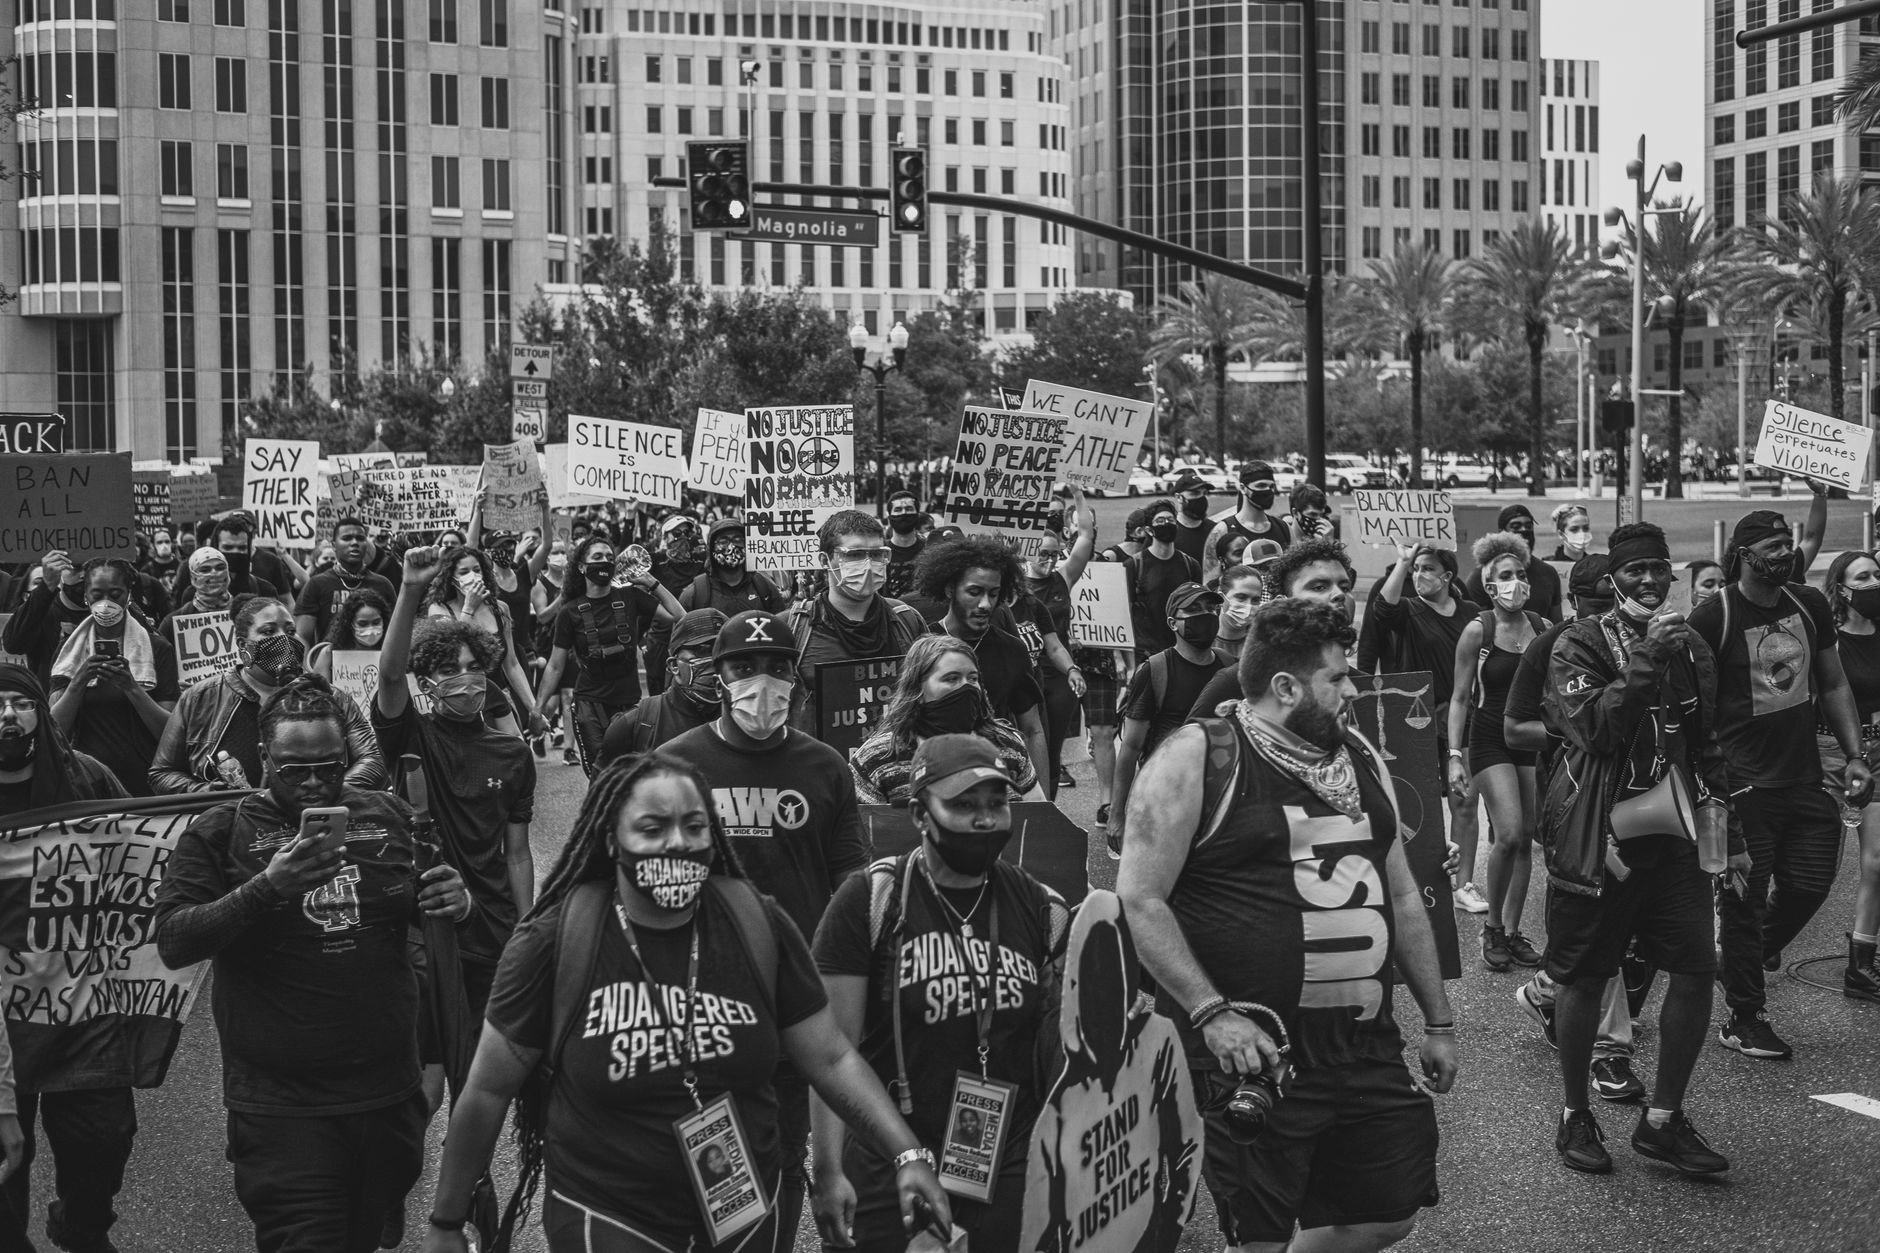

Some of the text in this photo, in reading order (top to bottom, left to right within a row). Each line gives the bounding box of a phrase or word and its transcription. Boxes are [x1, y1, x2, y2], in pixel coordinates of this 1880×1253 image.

[757, 217, 864, 238] Magnolia AV
[514, 348, 550, 358] DETOUR
[517, 384, 542, 395] WEST
[1032, 390, 1138, 428] WE CAN'T
[515, 422, 538, 436] 408
[747, 408, 854, 438] NO JUSTICE
[961, 410, 1068, 445] NO JUSTICE
[1772, 404, 1842, 442] Silence
[576, 422, 676, 458] SILENCE
[1765, 425, 1856, 462] Perpetuates
[251, 447, 302, 472] SAY
[619, 454, 635, 466] IS
[750, 438, 839, 474] NO PEACE
[956, 440, 1061, 472] NO PEACE
[1772, 445, 1850, 484] Violence
[16, 466, 90, 490] BAN
[412, 470, 424, 480] BE
[431, 468, 446, 478] NO
[574, 464, 680, 501] COMPLICITY
[950, 466, 1056, 500] NO RACIST
[1094, 475, 1116, 490] Floyd
[134, 484, 148, 494] NO
[248, 477, 312, 506] THEIR
[368, 491, 394, 502] LIVES
[400, 484, 404, 492] 4
[412, 482, 440, 492] BLACK
[746, 476, 775, 508] NO
[18, 494, 82, 518] ALL
[361, 506, 456, 520] CENTURIES OF BLACK
[366, 500, 380, 510] WE
[416, 500, 449, 510] ALLOW
[948, 496, 1050, 531] POLICE
[1406, 492, 1452, 514] LIVES
[362, 516, 392, 528] LIVES
[424, 519, 460, 529] MATTER
[746, 509, 816, 537] POLICE
[1364, 517, 1452, 540] MATTER
[1, 527, 130, 552] CHOKEHOLDS
[755, 554, 814, 570] MATTER
[176, 616, 212, 632] WHEN
[745, 618, 773, 642] X
[855, 661, 897, 680] BLM
[860, 686, 892, 704] NO
[30, 874, 161, 908] ESTMOS
[26, 911, 146, 953] UNDOS
[924, 976, 1024, 1024] SPECES
[959, 1092, 1000, 1112] PRESS
[688, 1117, 730, 1148] PRESS
[980, 1114, 998, 1152] MEDIA
[1081, 1094, 1140, 1168] STAND
[722, 1129, 746, 1174] MEDIA
[944, 1164, 986, 1182] ACCESS
[1094, 1139, 1131, 1196] FOR
[716, 1191, 754, 1221] ACCESS
[1074, 1158, 1150, 1249] JUSTICE
